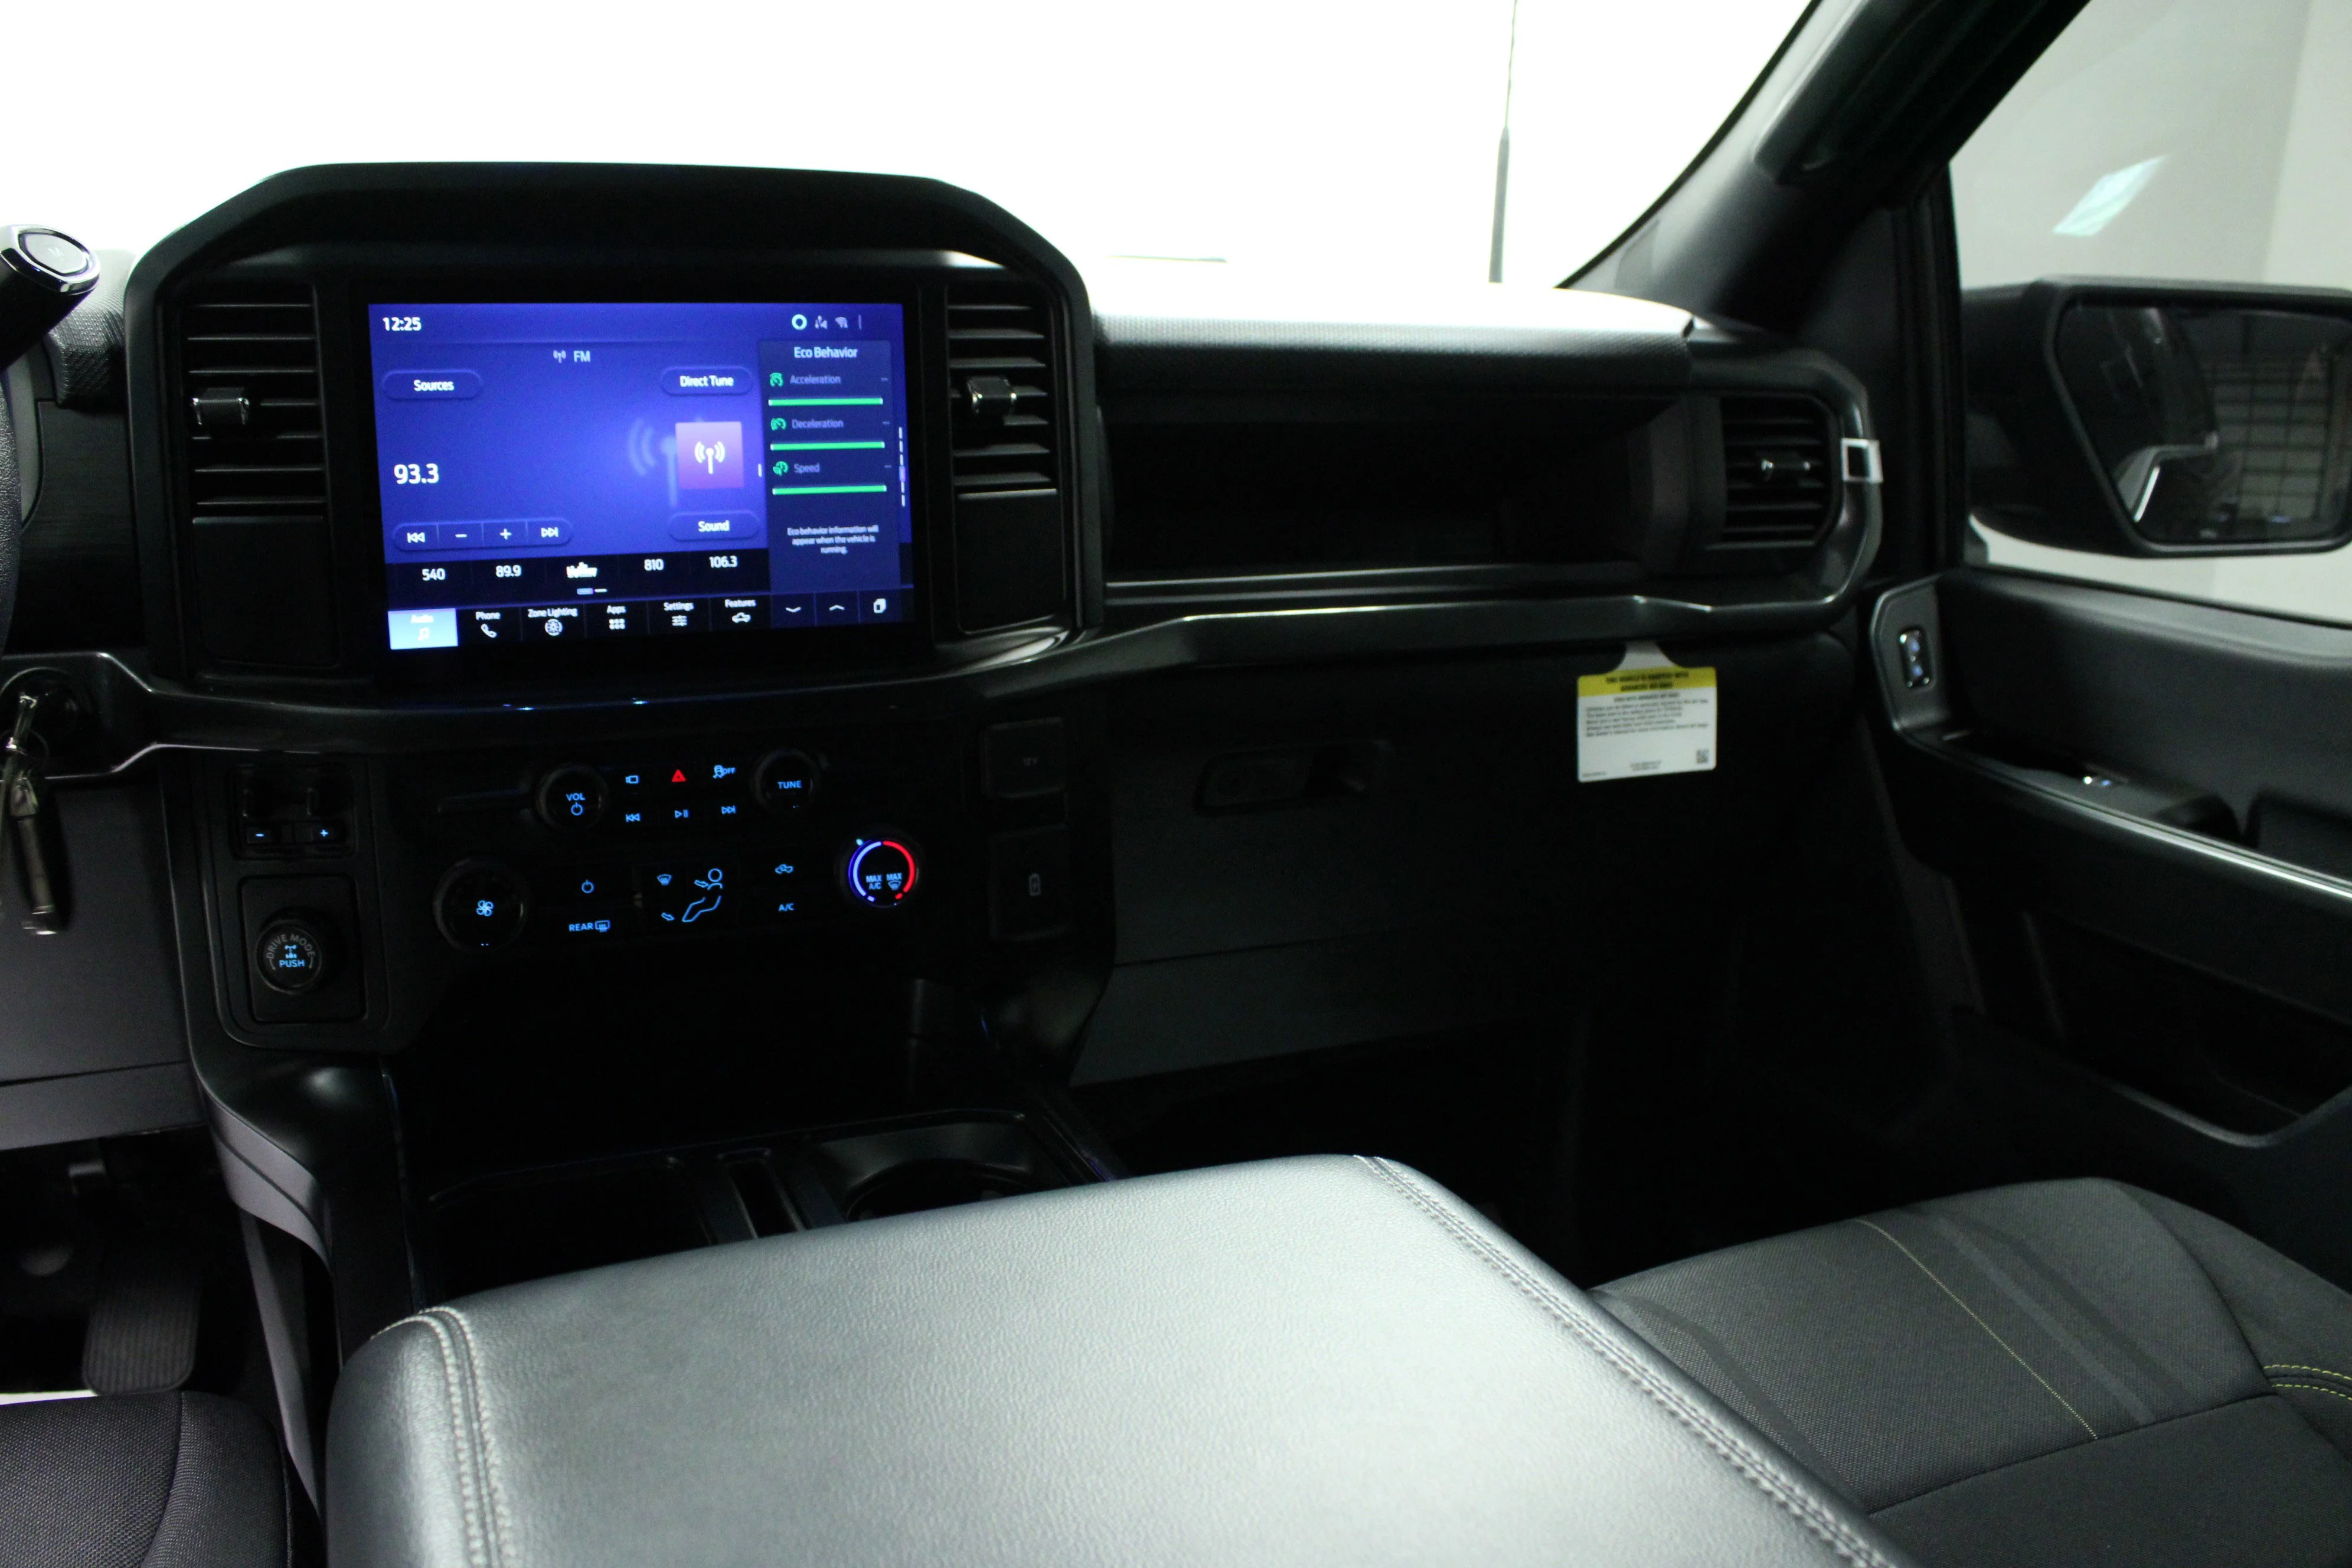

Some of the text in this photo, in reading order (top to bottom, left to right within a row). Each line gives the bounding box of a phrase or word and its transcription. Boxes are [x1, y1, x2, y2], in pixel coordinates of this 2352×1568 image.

[382, 316, 422, 331] 12:25
[573, 350, 591, 362] FM
[793, 346, 858, 358] Eco Behavior
[680, 375, 734, 387] Direct Tune
[789, 374, 842, 385] Acceleration
[413, 379, 455, 392] Sources
[791, 419, 844, 429] Deceleration
[394, 463, 439, 485] 93.3
[793, 462, 821, 475] Speed
[698, 520, 730, 533] Sound
[643, 558, 664, 571] 810
[709, 555, 738, 569] 106.3
[422, 567, 446, 582] 540
[495, 564, 522, 578] 89.9
[663, 602, 694, 612] Settings
[724, 599, 756, 608] Features
[475, 611, 501, 620] Phone
[527, 607, 579, 618] Zone Lighting
[606, 605, 626, 615] Apps
[777, 780, 802, 789] TUNE
[566, 792, 586, 802] VOL
[865, 875, 882, 883] MAX
[886, 873, 903, 881] MAX
[778, 903, 794, 912] A/C
[569, 922, 594, 932] REAR
[266, 934, 316, 959] DRIVE MODE
[279, 959, 305, 968] PUSH
